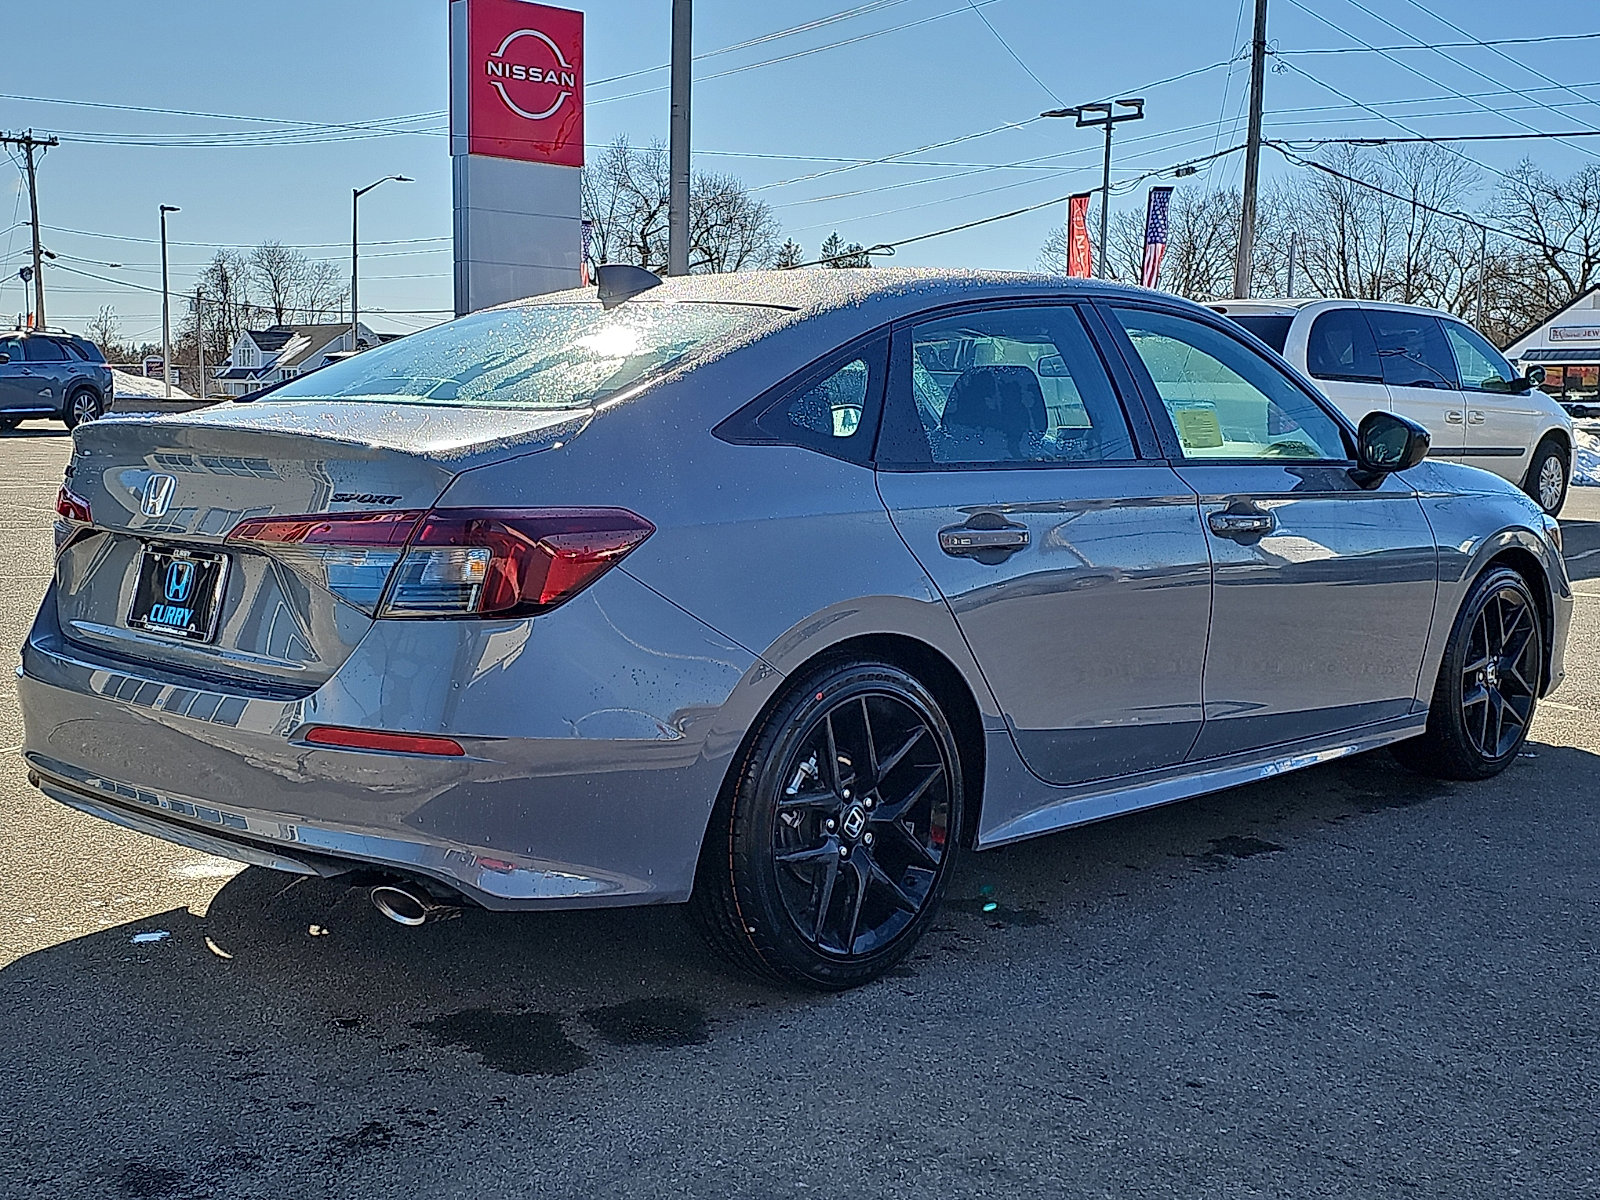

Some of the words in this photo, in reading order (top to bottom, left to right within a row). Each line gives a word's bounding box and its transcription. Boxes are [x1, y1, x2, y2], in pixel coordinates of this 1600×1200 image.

[487, 60, 575, 87] NISSAN
[330, 493, 402, 505] SPORT
[149, 603, 194, 627] CURRY
